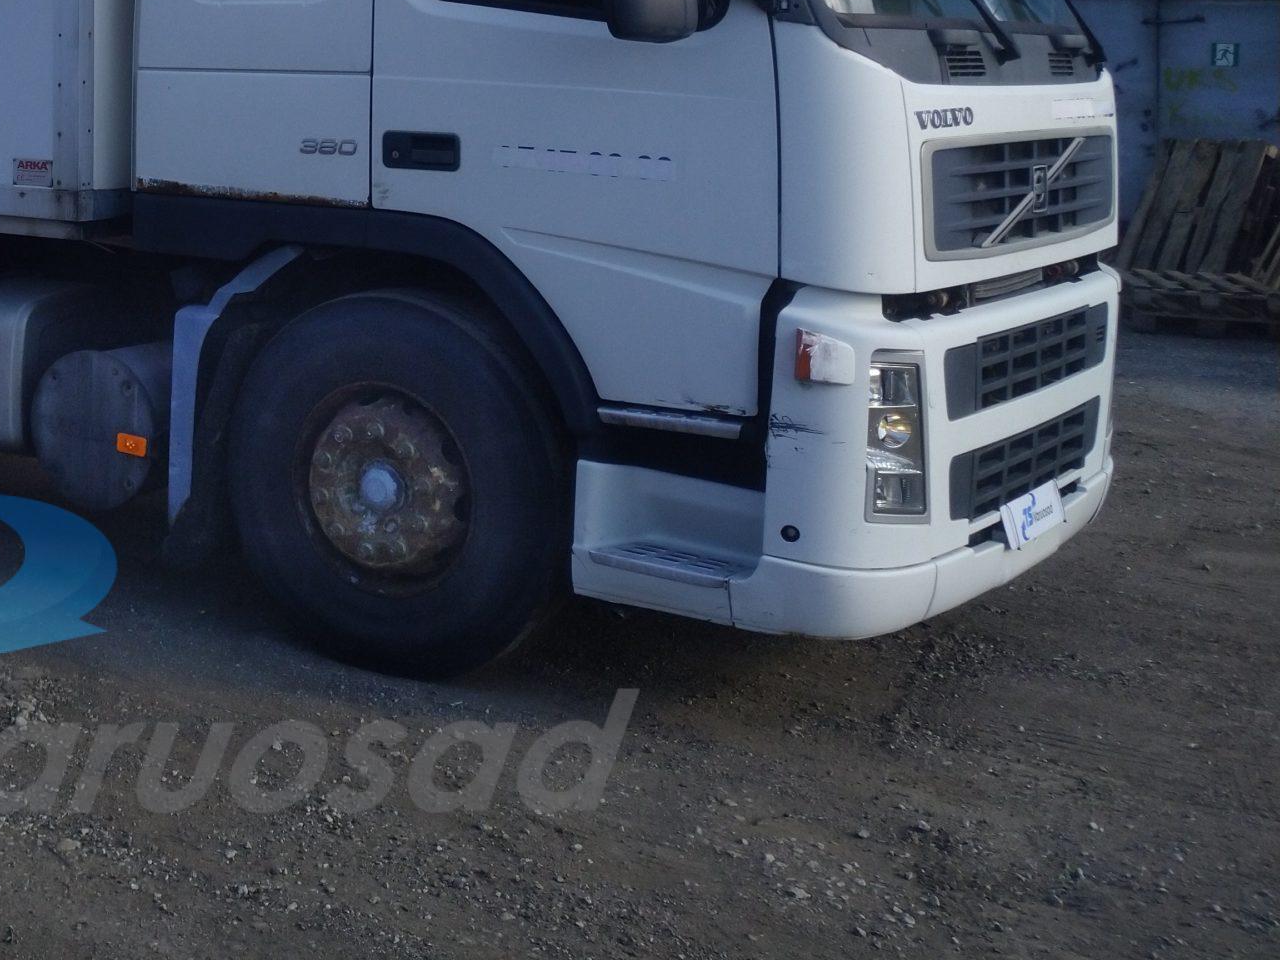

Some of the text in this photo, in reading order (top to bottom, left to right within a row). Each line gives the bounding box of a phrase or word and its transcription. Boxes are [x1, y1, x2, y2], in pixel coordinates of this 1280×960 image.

[914, 106, 974, 130] VOLVO
[299, 139, 358, 156] 380
[16, 160, 49, 171] ARKA
